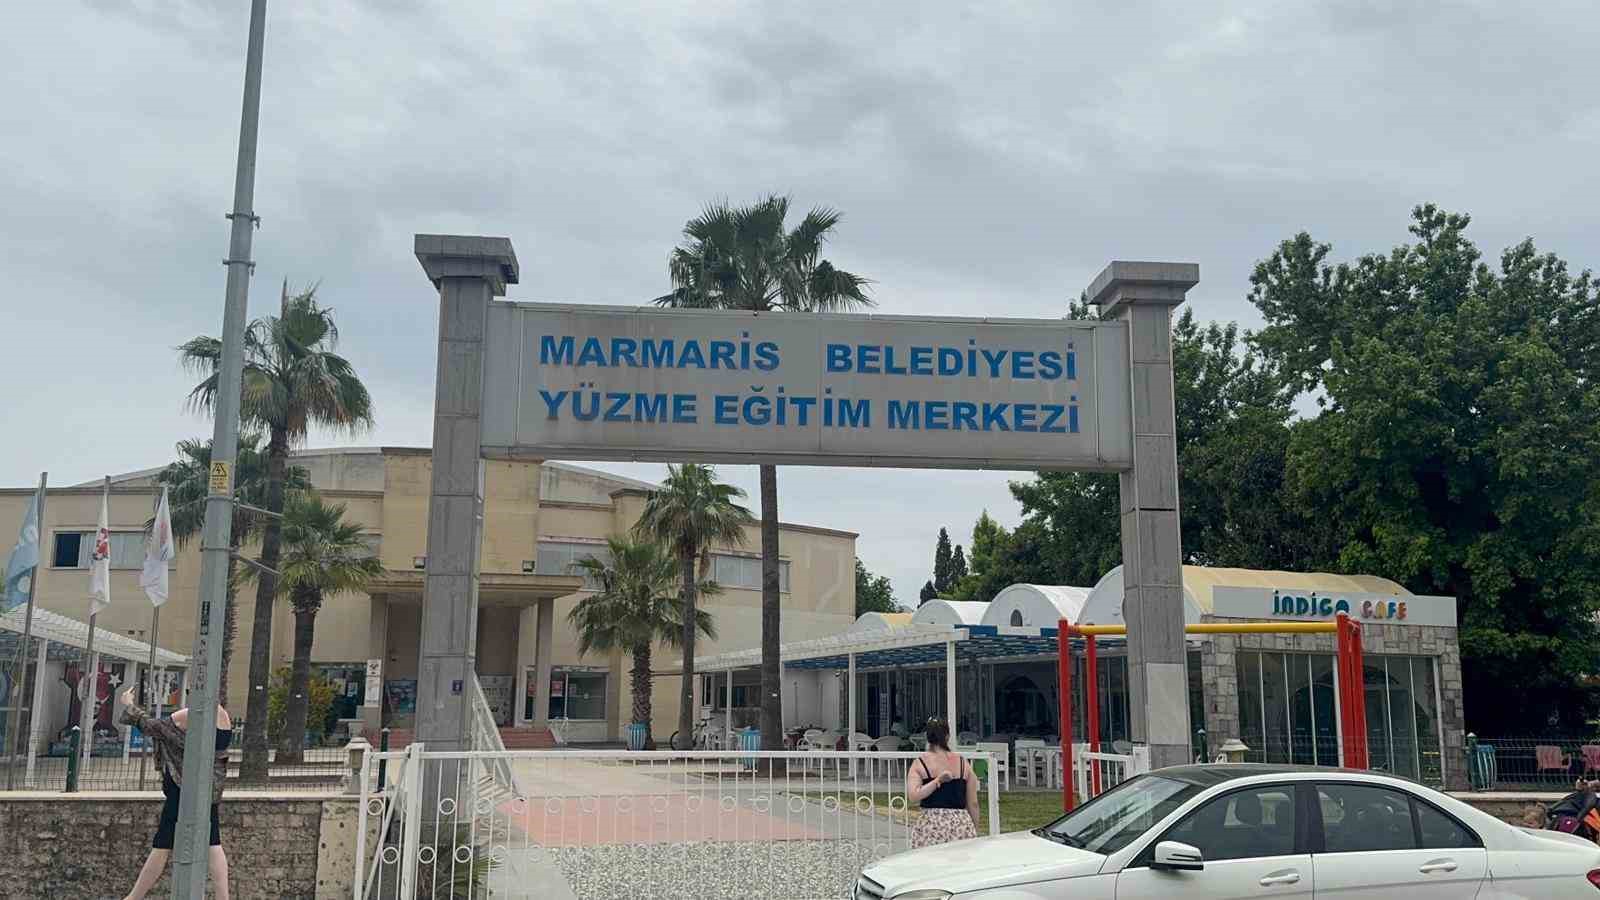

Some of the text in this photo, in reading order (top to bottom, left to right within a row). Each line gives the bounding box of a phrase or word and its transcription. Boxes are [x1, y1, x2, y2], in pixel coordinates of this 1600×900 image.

[539, 331, 1077, 380] MARMARİS BELEDİYESİ
[538, 381, 1080, 433] YÜZME EĞİTİM MERKEZİ
